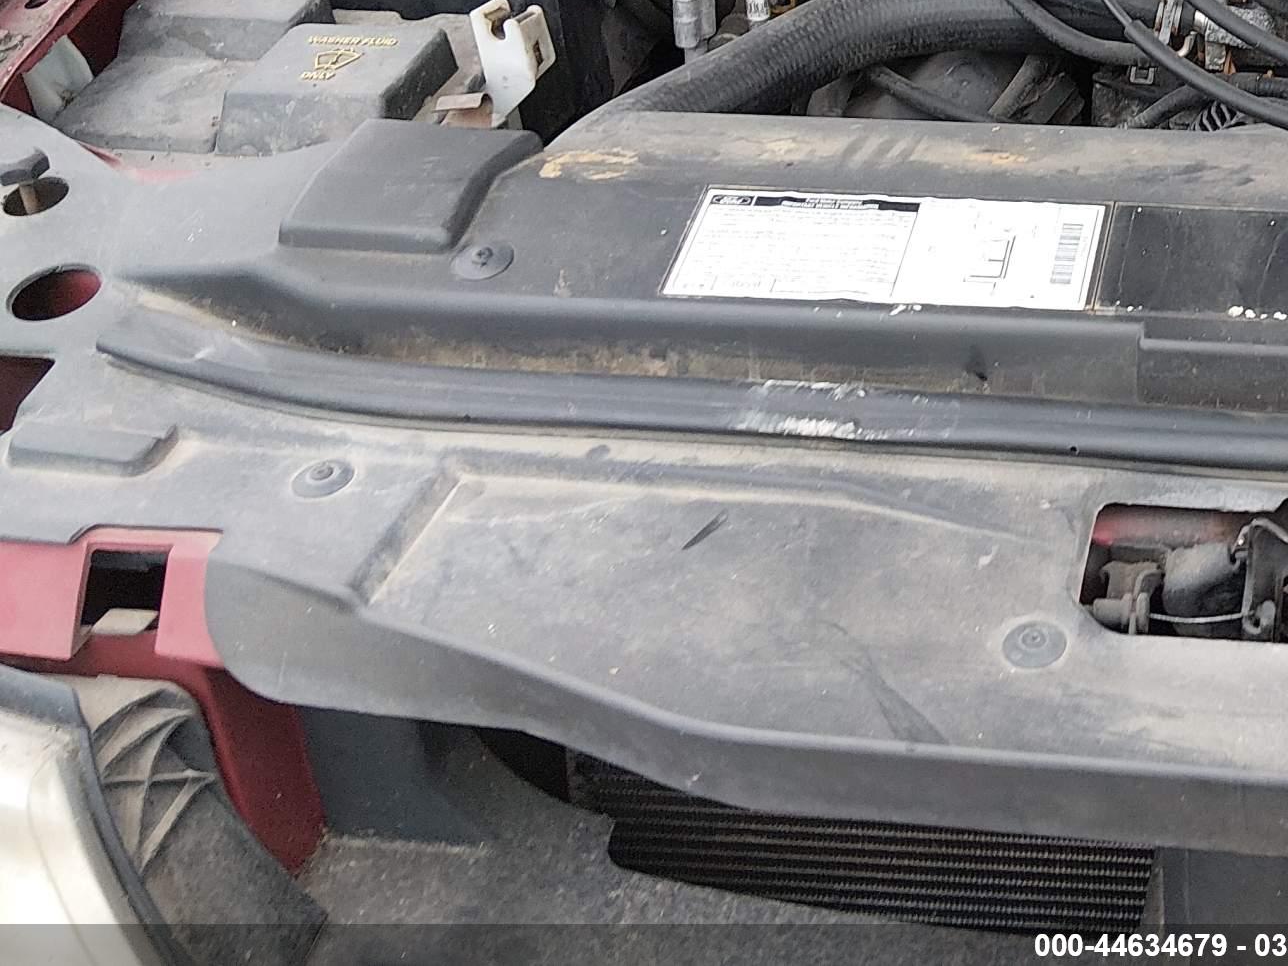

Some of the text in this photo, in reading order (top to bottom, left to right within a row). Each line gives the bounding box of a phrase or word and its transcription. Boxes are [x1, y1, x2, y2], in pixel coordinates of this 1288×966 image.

[307, 35, 399, 47] WASHER FLUID
[300, 70, 336, 81] ONLY
